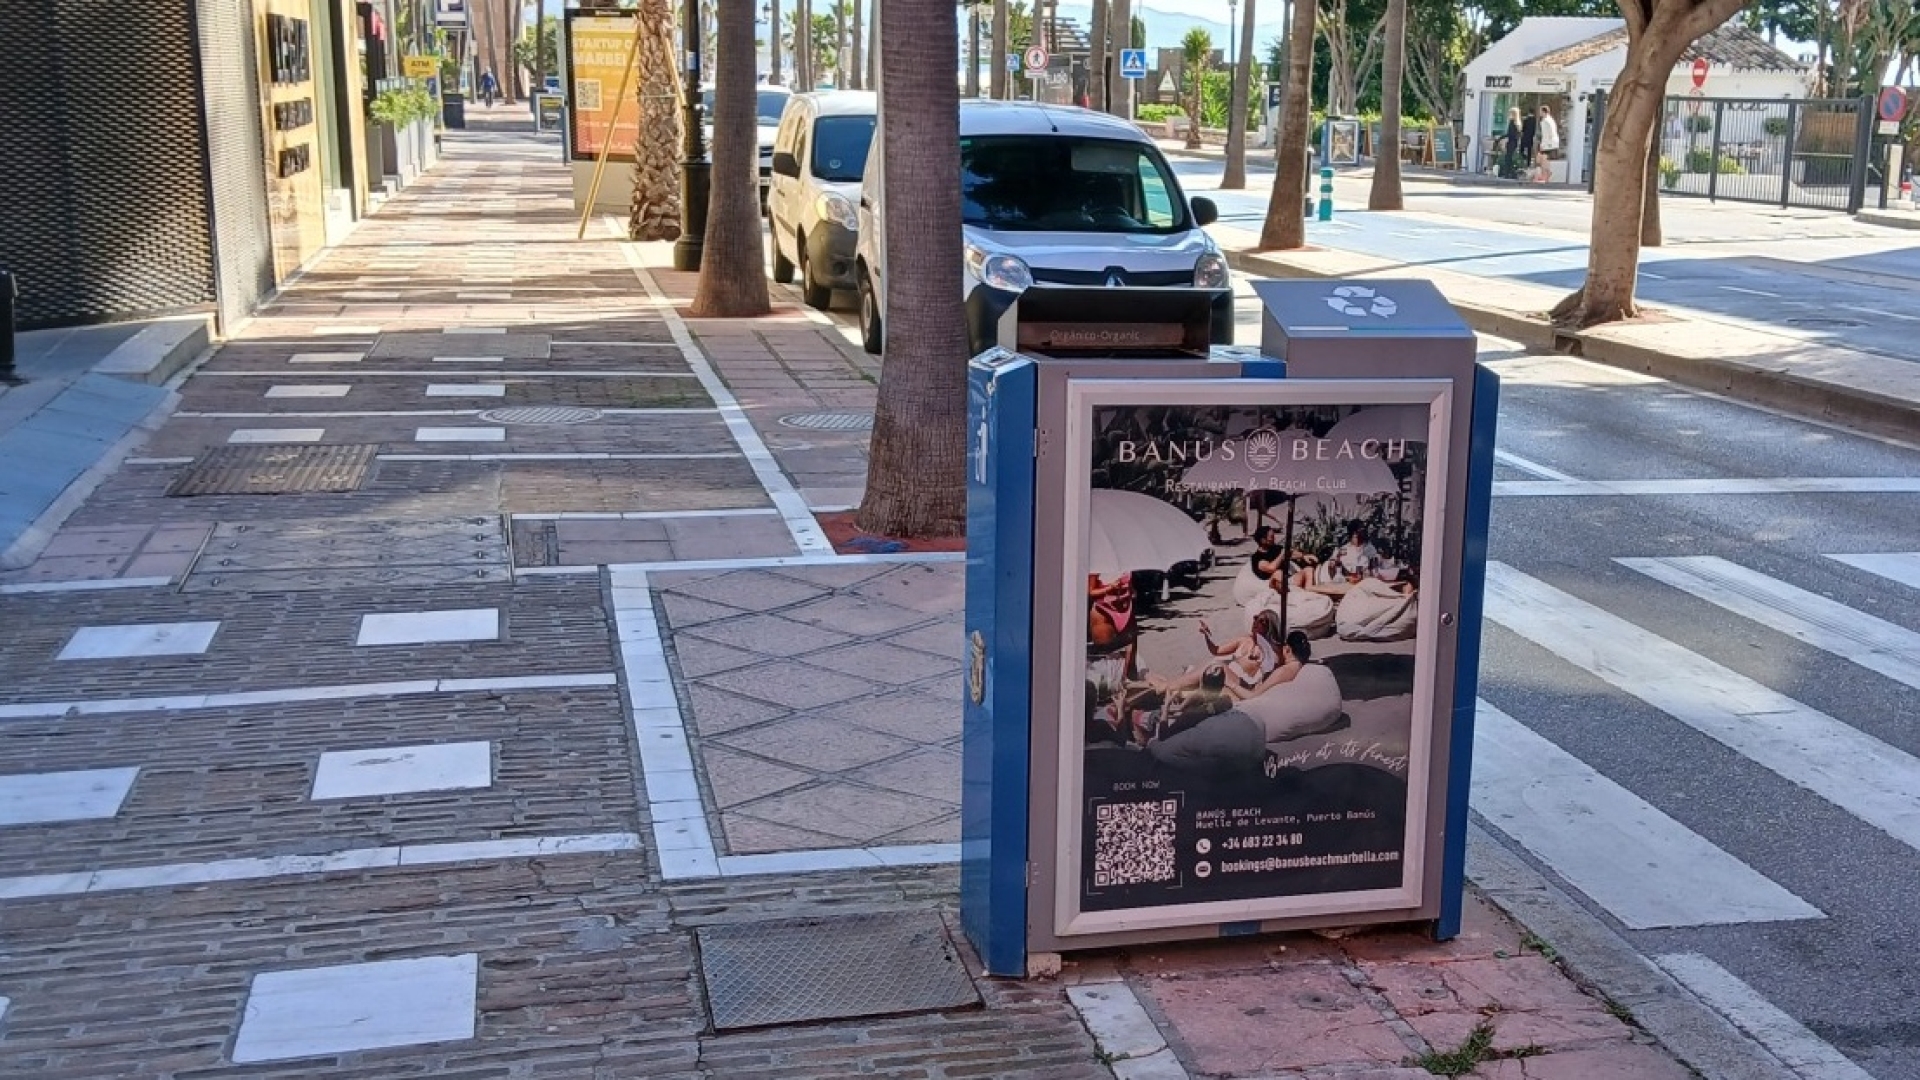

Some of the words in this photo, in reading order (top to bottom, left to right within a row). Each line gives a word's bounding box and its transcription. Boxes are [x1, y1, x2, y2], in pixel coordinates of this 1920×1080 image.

[574, 51, 641, 67] MARBEL
[1291, 437, 1406, 461] BEACH
[1249, 476, 1260, 490] &
[1269, 476, 1307, 491] BEACH
[1316, 475, 1347, 490] CLUB
[1113, 782, 1136, 792] BOOK
[1141, 780, 1160, 789] NOW
[1232, 807, 1262, 817] BEACH
[1195, 819, 1232, 829] Muelle
[1237, 818, 1249, 826] de
[1254, 815, 1301, 826] Levante,
[1306, 812, 1342, 822] Puerto
[1221, 837, 1240, 850] +34
[1261, 834, 1274, 848] 22
[1275, 834, 1289, 847] 34
[1290, 832, 1303, 845] 80
[1221, 850, 1400, 873] bookings@banusbeachmarbella.com
